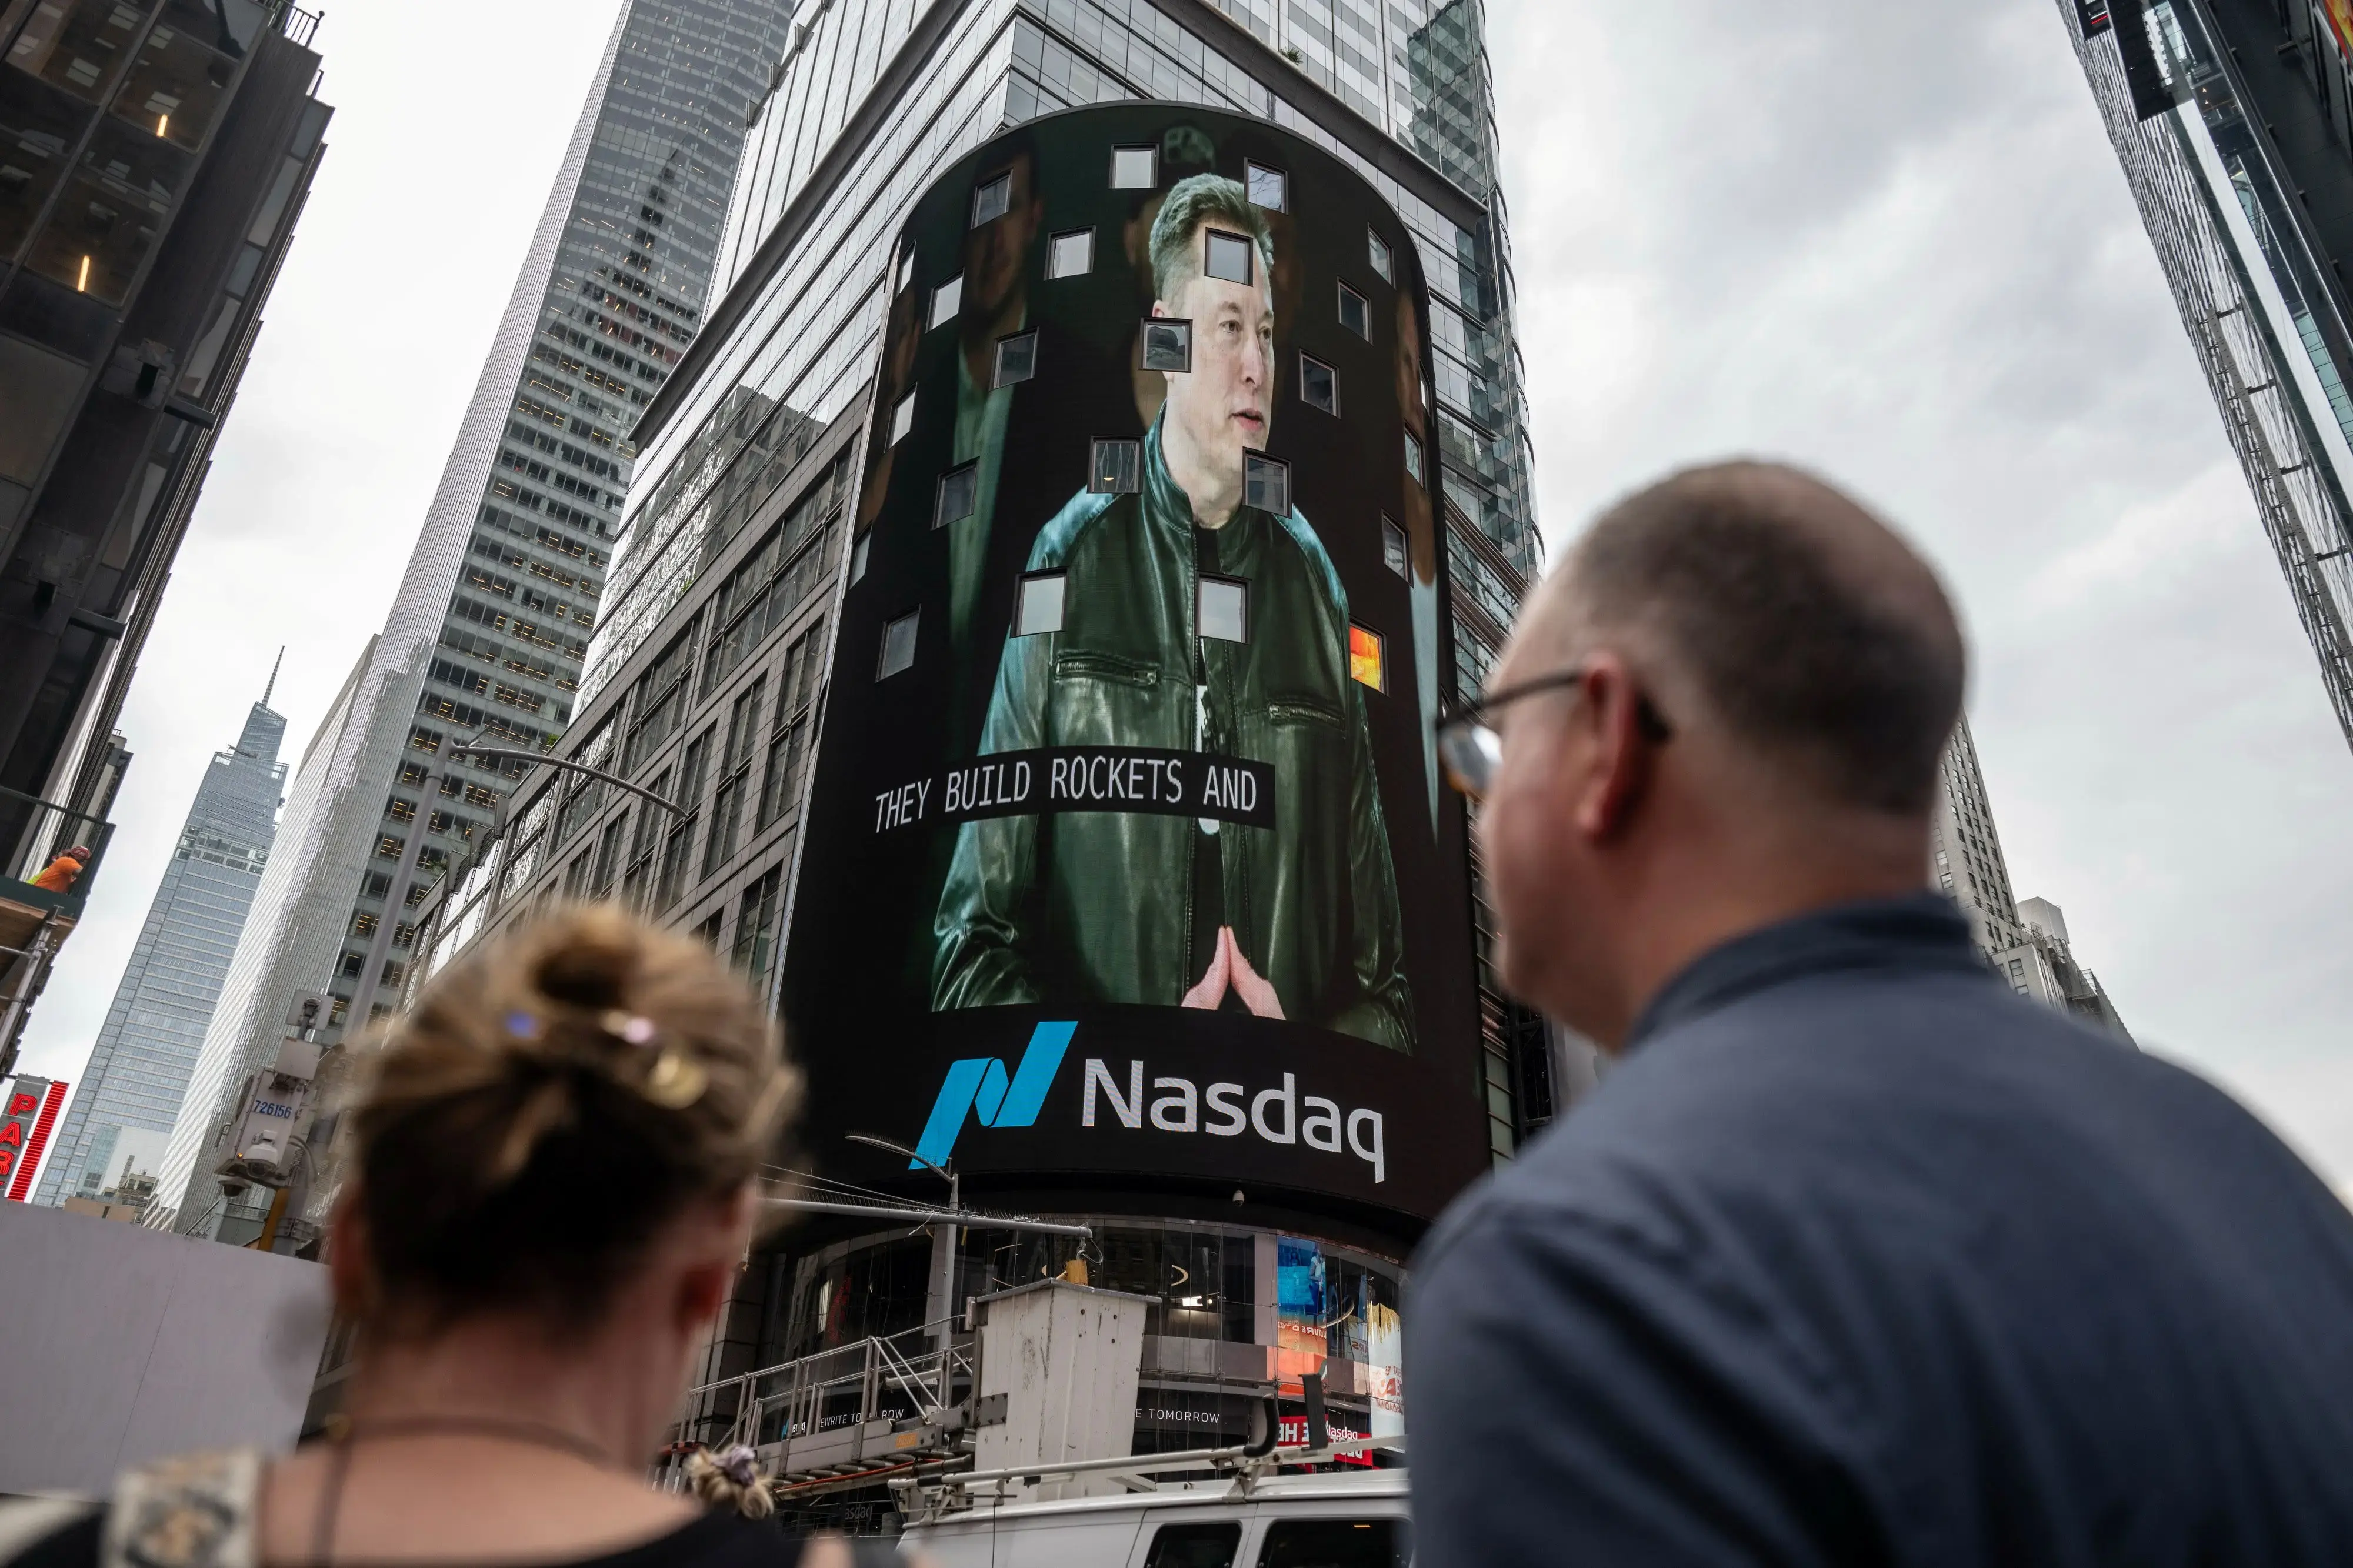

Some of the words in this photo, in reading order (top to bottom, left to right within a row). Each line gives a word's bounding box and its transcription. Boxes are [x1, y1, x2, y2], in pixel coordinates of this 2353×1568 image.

[876, 778, 931, 833] THEY
[945, 760, 1031, 813] BUILD
[1050, 755, 1182, 803] ROCKETS
[1203, 765, 1257, 812] AND
[254, 1100, 292, 1119] 726156
[1082, 1058, 1385, 1184] Nasdaq
[0, 1093, 37, 1186] PAR
[820, 1414, 847, 1428] EWRITE
[1148, 1409, 1219, 1423] TOMORROW
